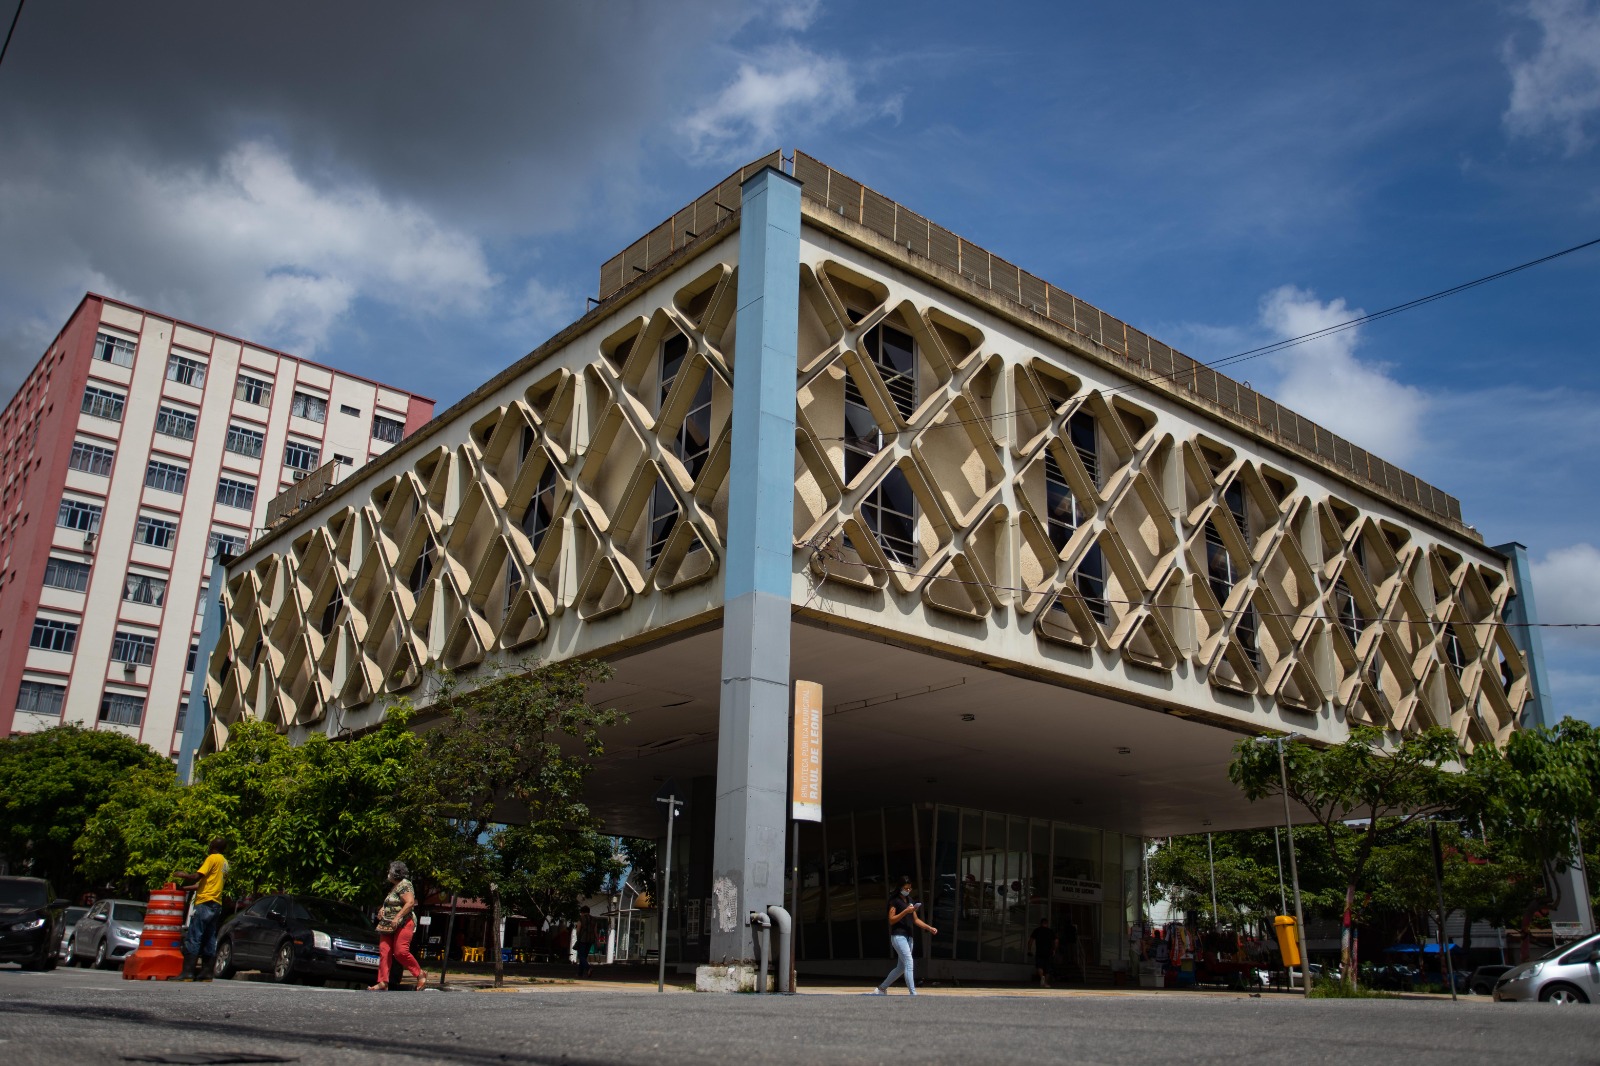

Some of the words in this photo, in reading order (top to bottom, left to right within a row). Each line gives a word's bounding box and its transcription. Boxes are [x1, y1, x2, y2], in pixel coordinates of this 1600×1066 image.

[801, 688, 810, 726] MUNICIPAL
[810, 708, 820, 745] LEONI
[809, 748, 819, 765] DE
[800, 758, 809, 799] BIBLIOTECA
[809, 767, 819, 800] RAUL
